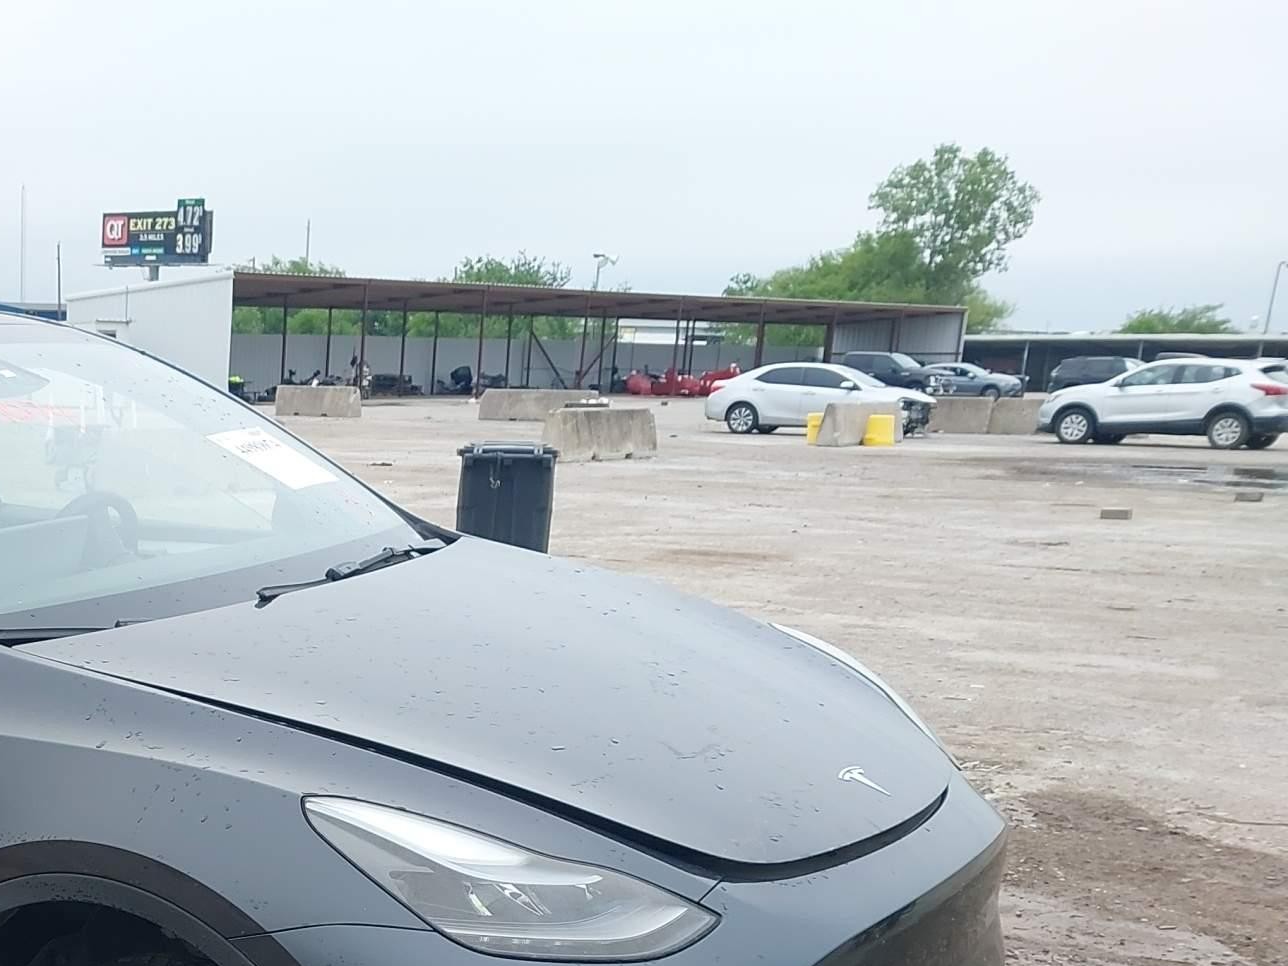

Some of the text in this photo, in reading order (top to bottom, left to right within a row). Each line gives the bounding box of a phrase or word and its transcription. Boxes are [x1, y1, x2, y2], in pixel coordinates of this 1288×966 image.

[106, 220, 124, 240] QT
[129, 217, 176, 231] EXIT 273
